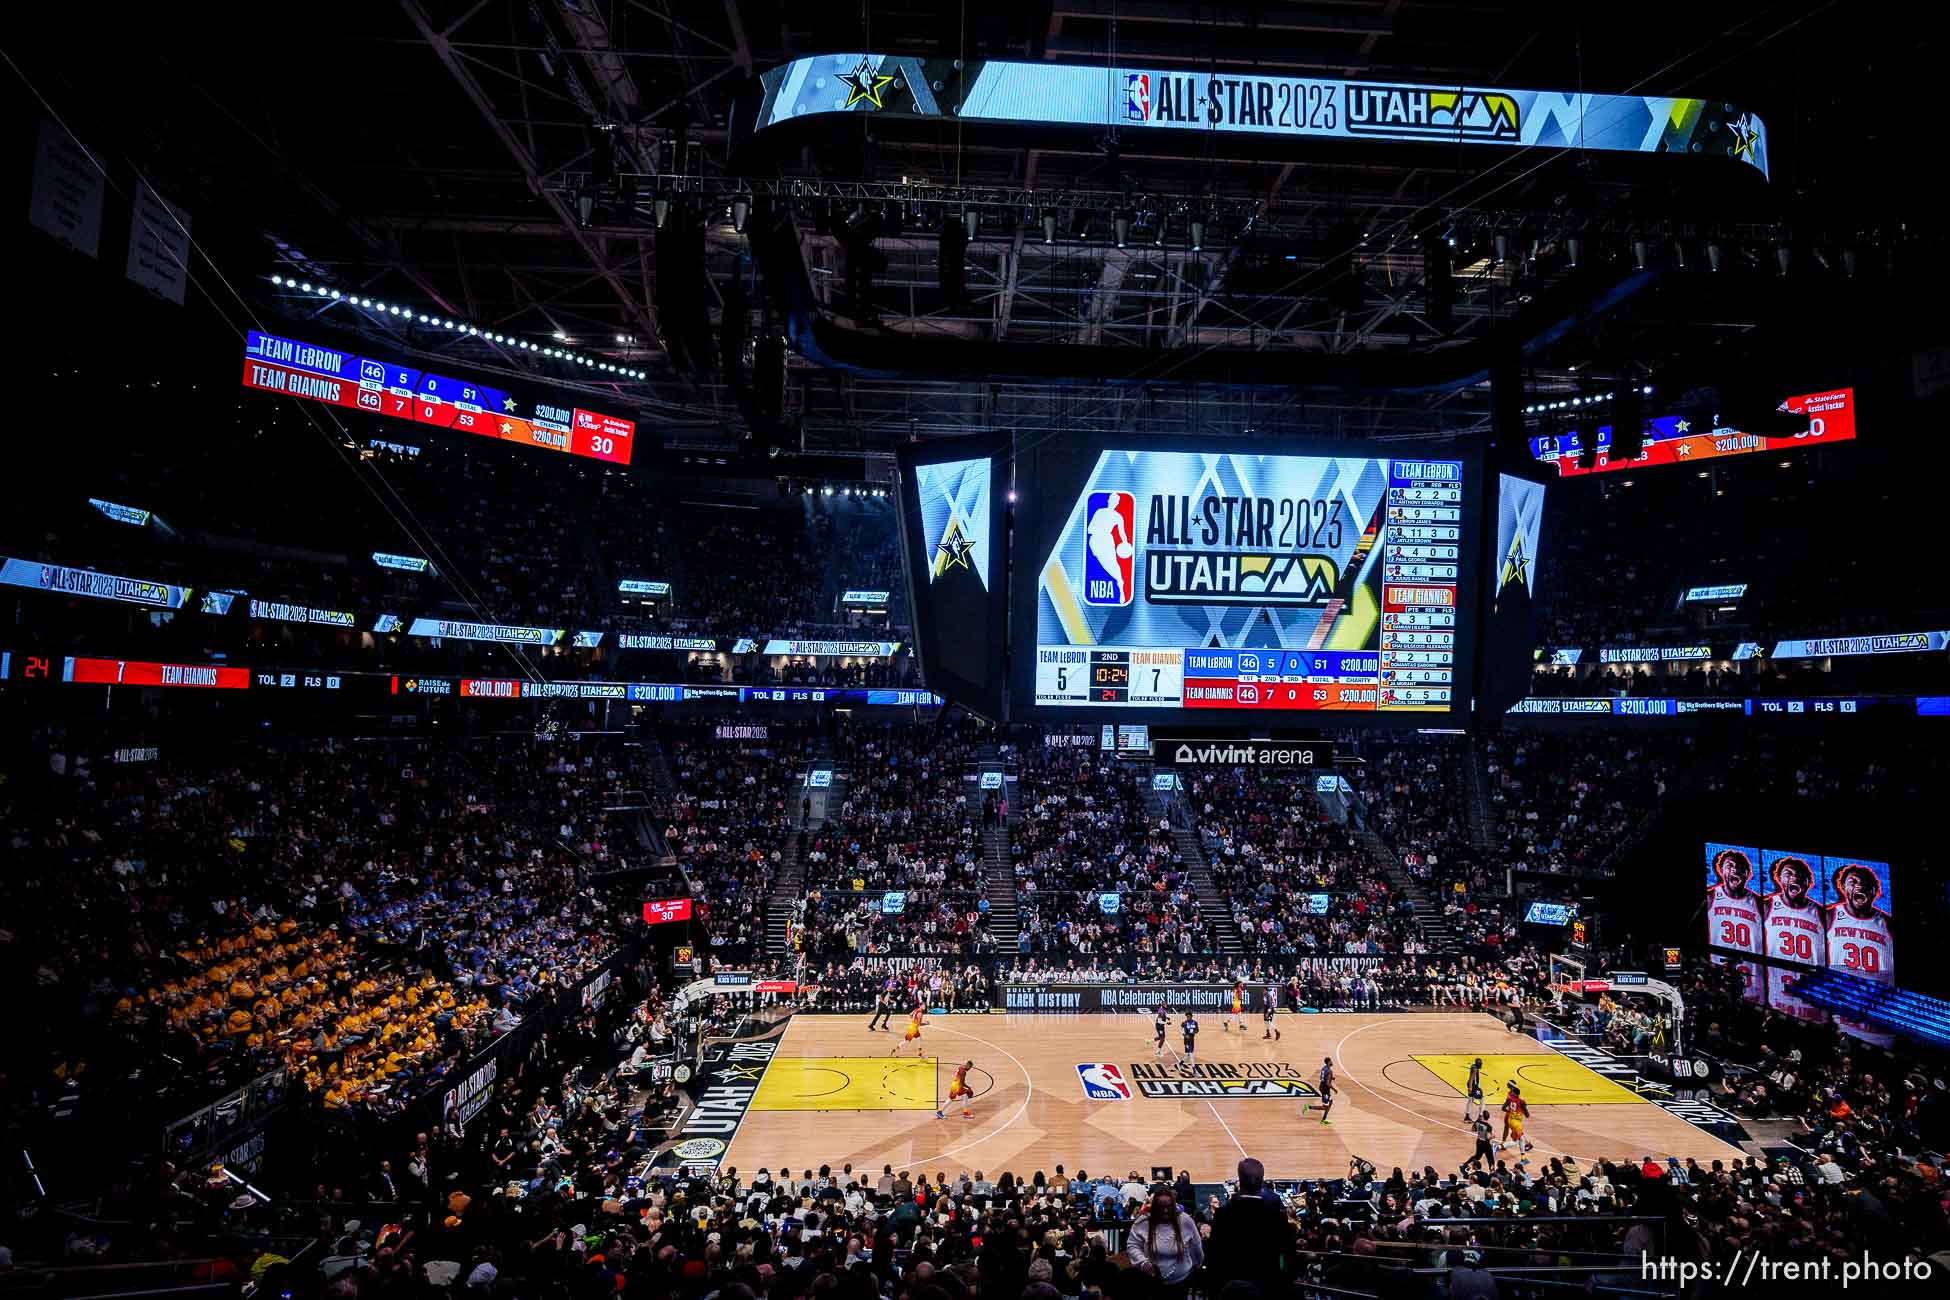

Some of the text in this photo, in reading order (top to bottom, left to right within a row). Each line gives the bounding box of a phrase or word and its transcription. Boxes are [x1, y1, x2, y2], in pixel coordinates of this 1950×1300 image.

[1278, 83, 1337, 129] 2023
[1350, 89, 1427, 124] UTAH
[259, 336, 570, 423] TEAM LeBRON 46 5 0 51 $200,000
[252, 365, 567, 448] TEAM GIANNIS 46 7 0 53 $200,000
[1808, 402, 1845, 412] Assist Tracker
[591, 436, 613, 454] 30
[1571, 433, 1605, 445] 5 0
[1600, 435, 1759, 466] 0 $200,000
[1401, 464, 1453, 480] TEAM LeBRON
[1415, 490, 1457, 500] 2 2 0
[1278, 498, 1343, 549] 2023
[1150, 555, 1237, 592] UTAH
[116, 580, 142, 596] UTAH
[1090, 580, 1114, 599] NBA
[1395, 590, 1448, 604] TEAM GIANNIS
[309, 609, 331, 621] UTAH
[1445, 616, 1450, 624] 0
[496, 628, 518, 639] UTAH
[1409, 634, 1415, 642] 3
[673, 638, 694, 648] UTAH
[1873, 637, 1899, 649] UTAH
[1040, 651, 1058, 663] TEAM
[1060, 651, 1087, 664] LeBRON
[1132, 653, 1151, 664] TEAM
[1152, 653, 1182, 665] GIANNIS
[1662, 648, 1685, 658] UTAH
[25, 657, 49, 677] 24
[1189, 656, 1207, 669] TEAM
[1207, 656, 1233, 669] LeBRON
[1242, 658, 1256, 668] 46
[1267, 658, 1275, 668] 5
[1290, 658, 1297, 668] 0
[1314, 659, 1327, 670] 51
[1340, 658, 1378, 672] $200,000
[117, 661, 322, 687] 7 TEAM GIANNIS TOL 2 FLS
[1058, 667, 1161, 692] 5 10:24 7
[418, 686, 451, 694] FUTURE
[581, 686, 602, 696] UTAH
[753, 691, 915, 704] TOL FLS TEAM
[1102, 690, 1116, 700] 24
[1186, 687, 1376, 703] TEAM GIANNIS 46 7 0 53 $200,000
[1562, 701, 1585, 710] UTAH
[1762, 703, 1783, 712] TOL
[1815, 703, 1833, 712] FLS
[752, 726, 768, 739] 2023
[1197, 744, 1313, 765] vivint arena
[661, 911, 673, 920] 30
[1714, 906, 1734, 917] NEW
[1772, 917, 1793, 926] NEW
[1721, 921, 1750, 947] 30
[1834, 927, 1856, 937] NEW
[1779, 932, 1812, 959] 30
[1843, 943, 1879, 973] 30
[1007, 993, 1081, 1008] BLACK HISTORY
[1101, 990, 1117, 1005] NBA
[1118, 989, 1166, 1005] Celebrates
[1167, 989, 1191, 1005] Black
[1192, 990, 1223, 1009] History
[1543, 1039, 1640, 1074] UTAH
[1092, 1090, 1116, 1098] NBA
[1241, 1063, 1301, 1078] 2023
[1143, 1082, 1225, 1094] UTAH
[681, 1086, 756, 1132] UTAH
